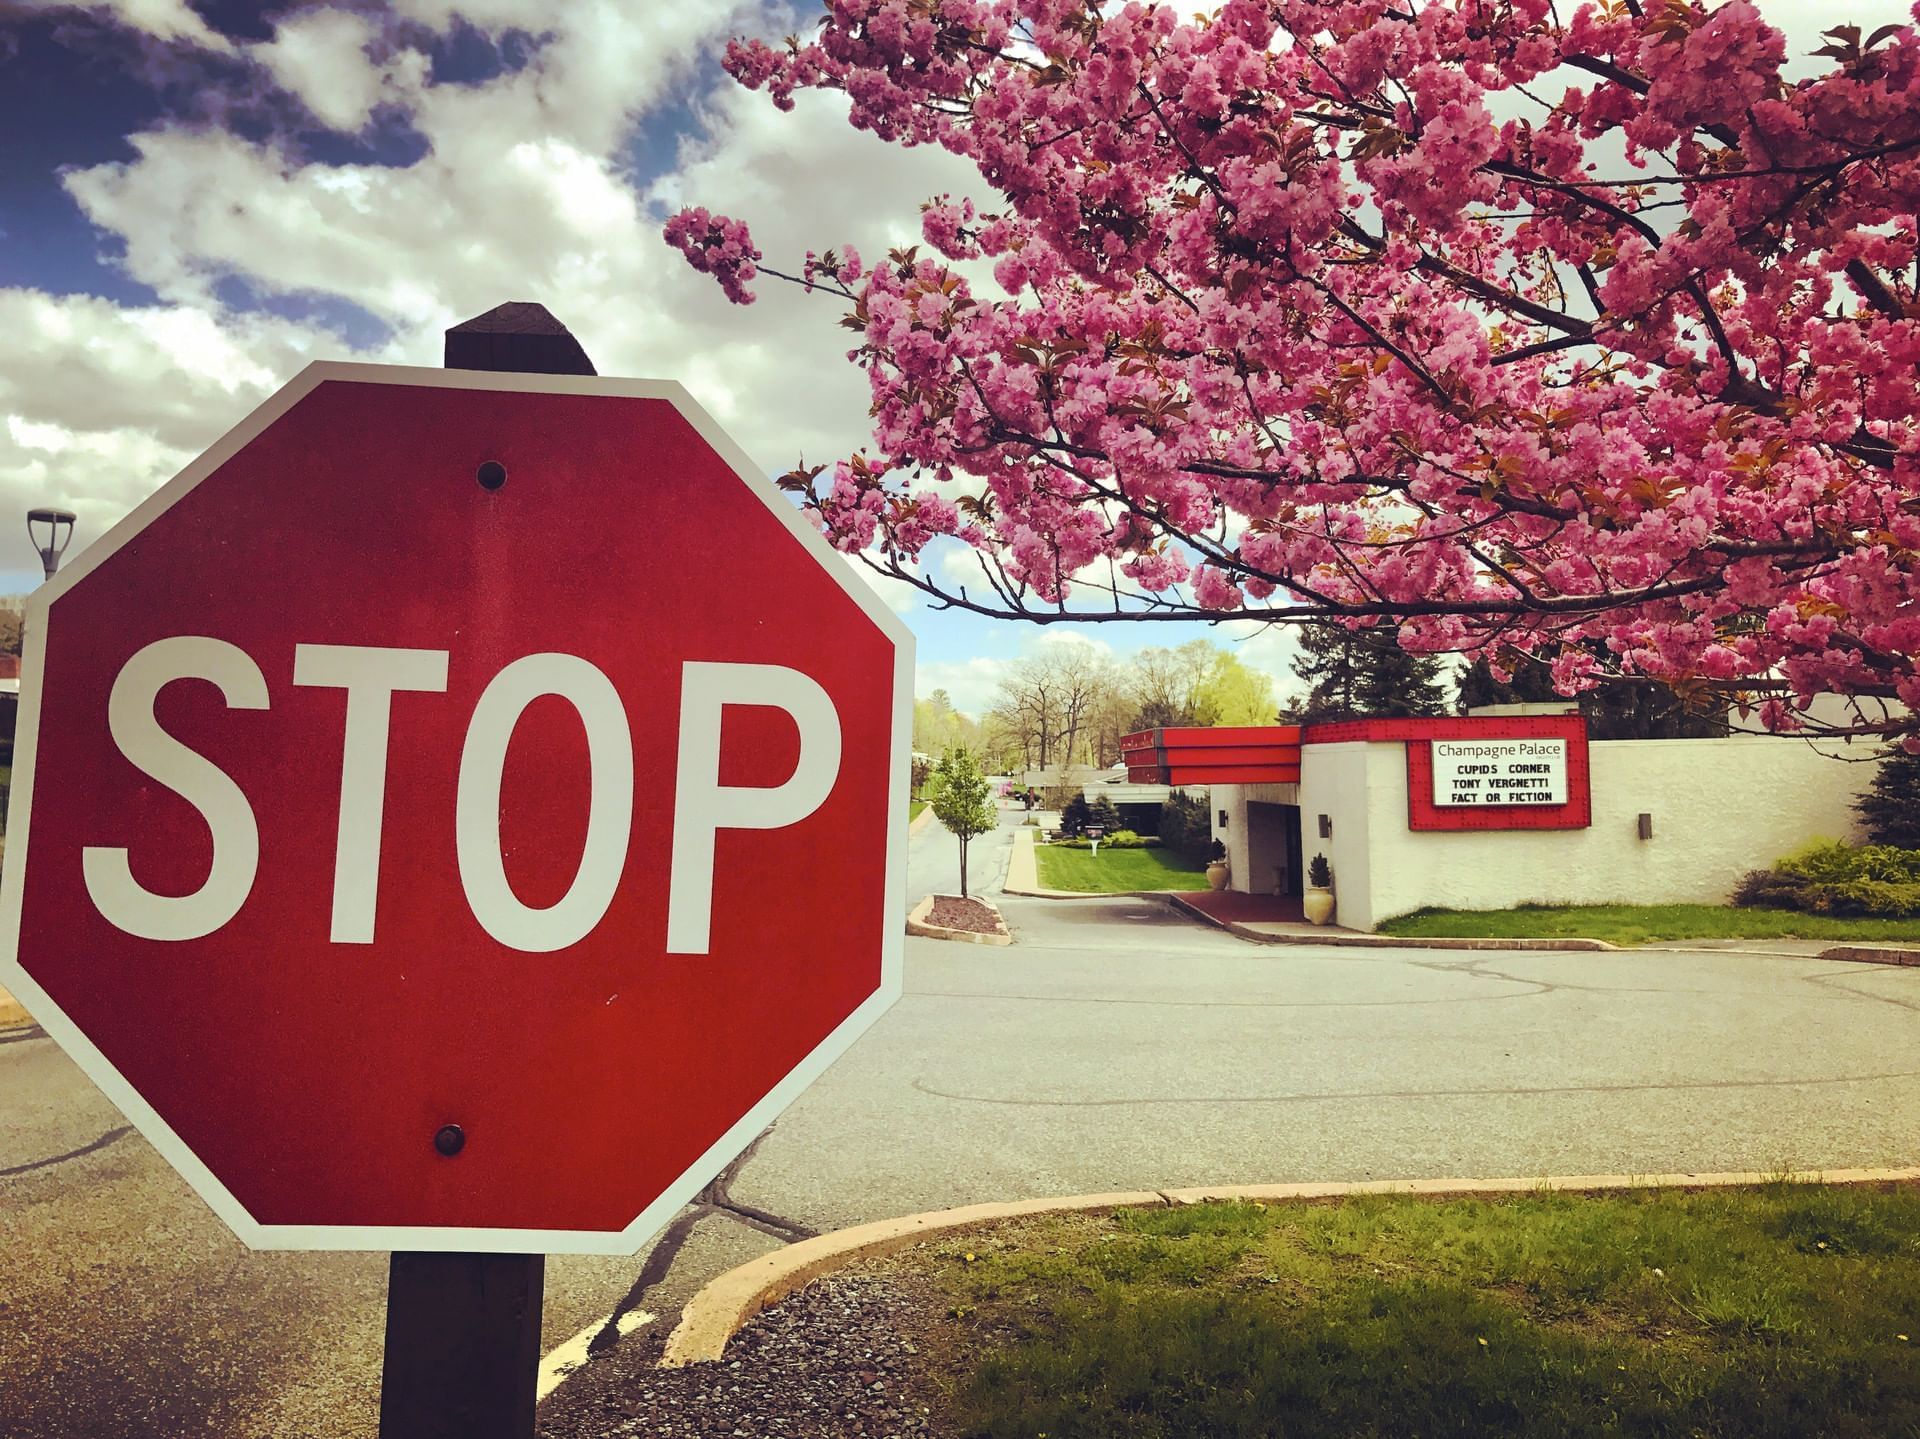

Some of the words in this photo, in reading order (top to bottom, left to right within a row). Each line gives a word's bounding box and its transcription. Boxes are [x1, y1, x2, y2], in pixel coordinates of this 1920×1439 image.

[1438, 744, 1515, 759] Champagne
[1519, 743, 1561, 756] Palace
[1457, 764, 1498, 775] CUPIDS
[1508, 763, 1551, 774] CORNER
[1452, 779, 1481, 789] TONY
[1488, 778, 1549, 788] VERGNETTI
[82, 636, 842, 954] STOP
[1451, 793, 1478, 803] FACT
[1485, 792, 1501, 802] OR
[1509, 792, 1553, 802] FICTION
